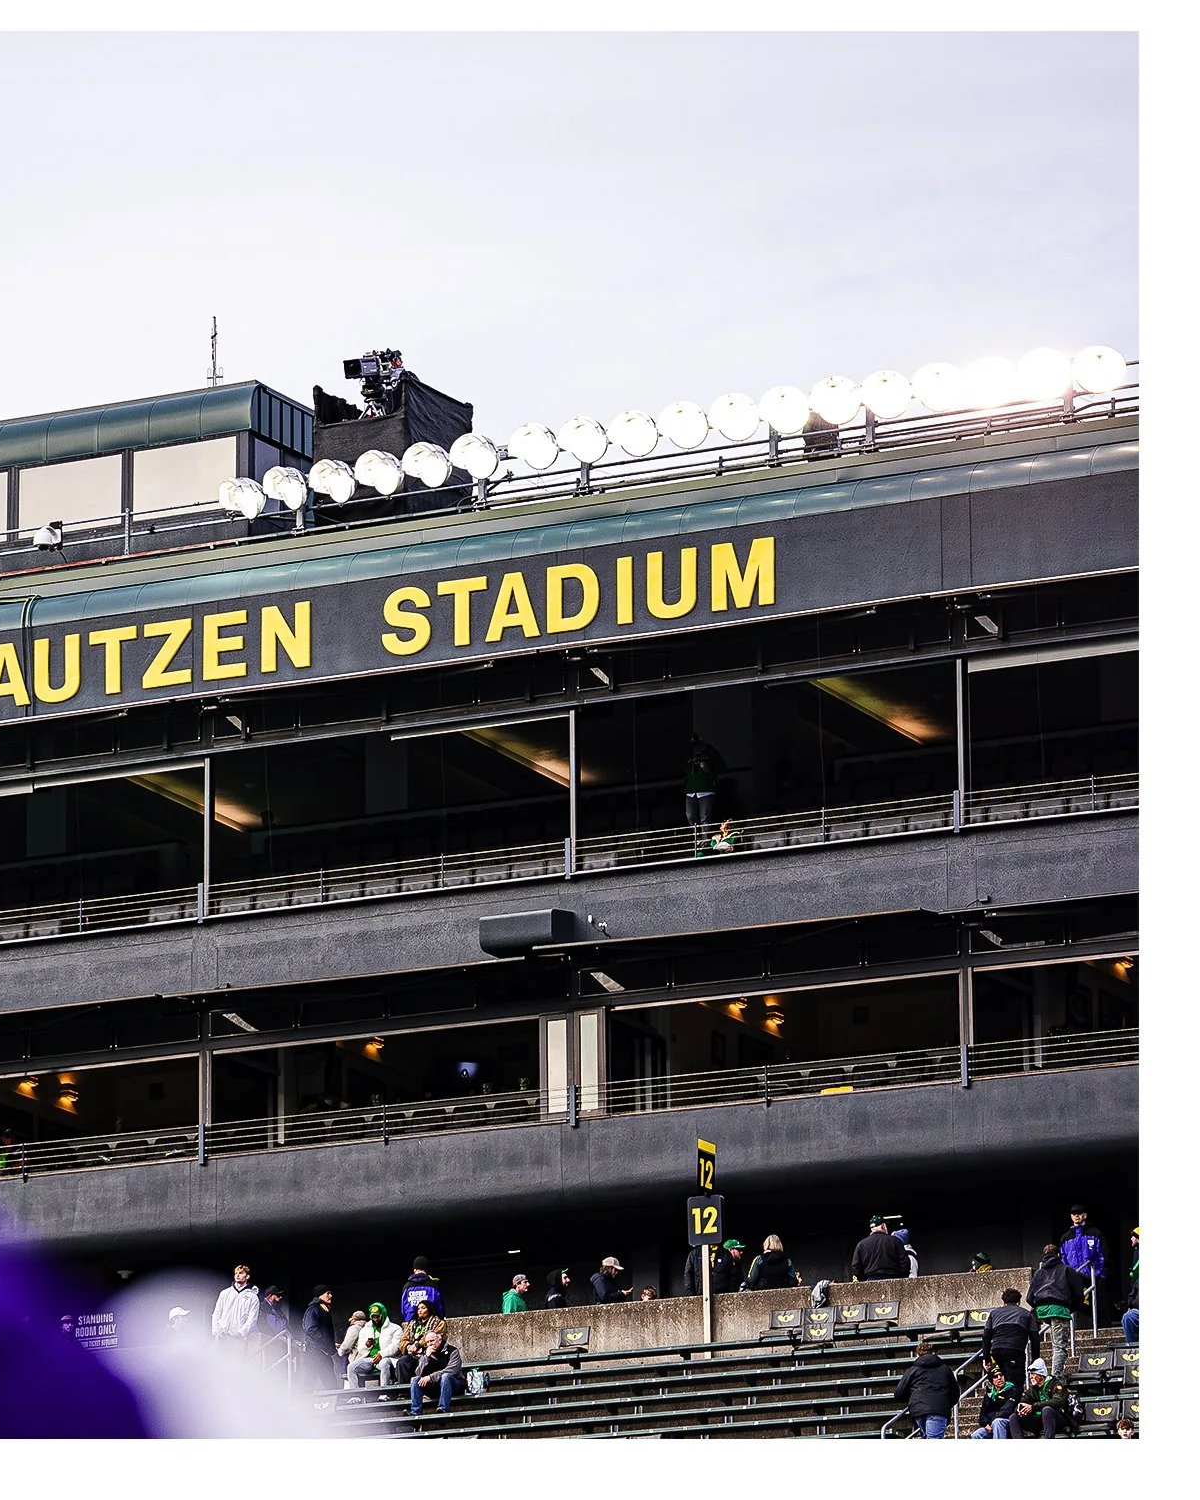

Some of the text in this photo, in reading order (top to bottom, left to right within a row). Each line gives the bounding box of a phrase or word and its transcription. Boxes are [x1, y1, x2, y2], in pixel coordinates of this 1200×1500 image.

[381, 536, 776, 656] STADIUM
[699, 1158, 714, 1190] 12
[691, 1206, 718, 1235] 12
[75, 1323, 116, 1337] ROOM ONLY
[78, 1312, 113, 1325] STANDING
